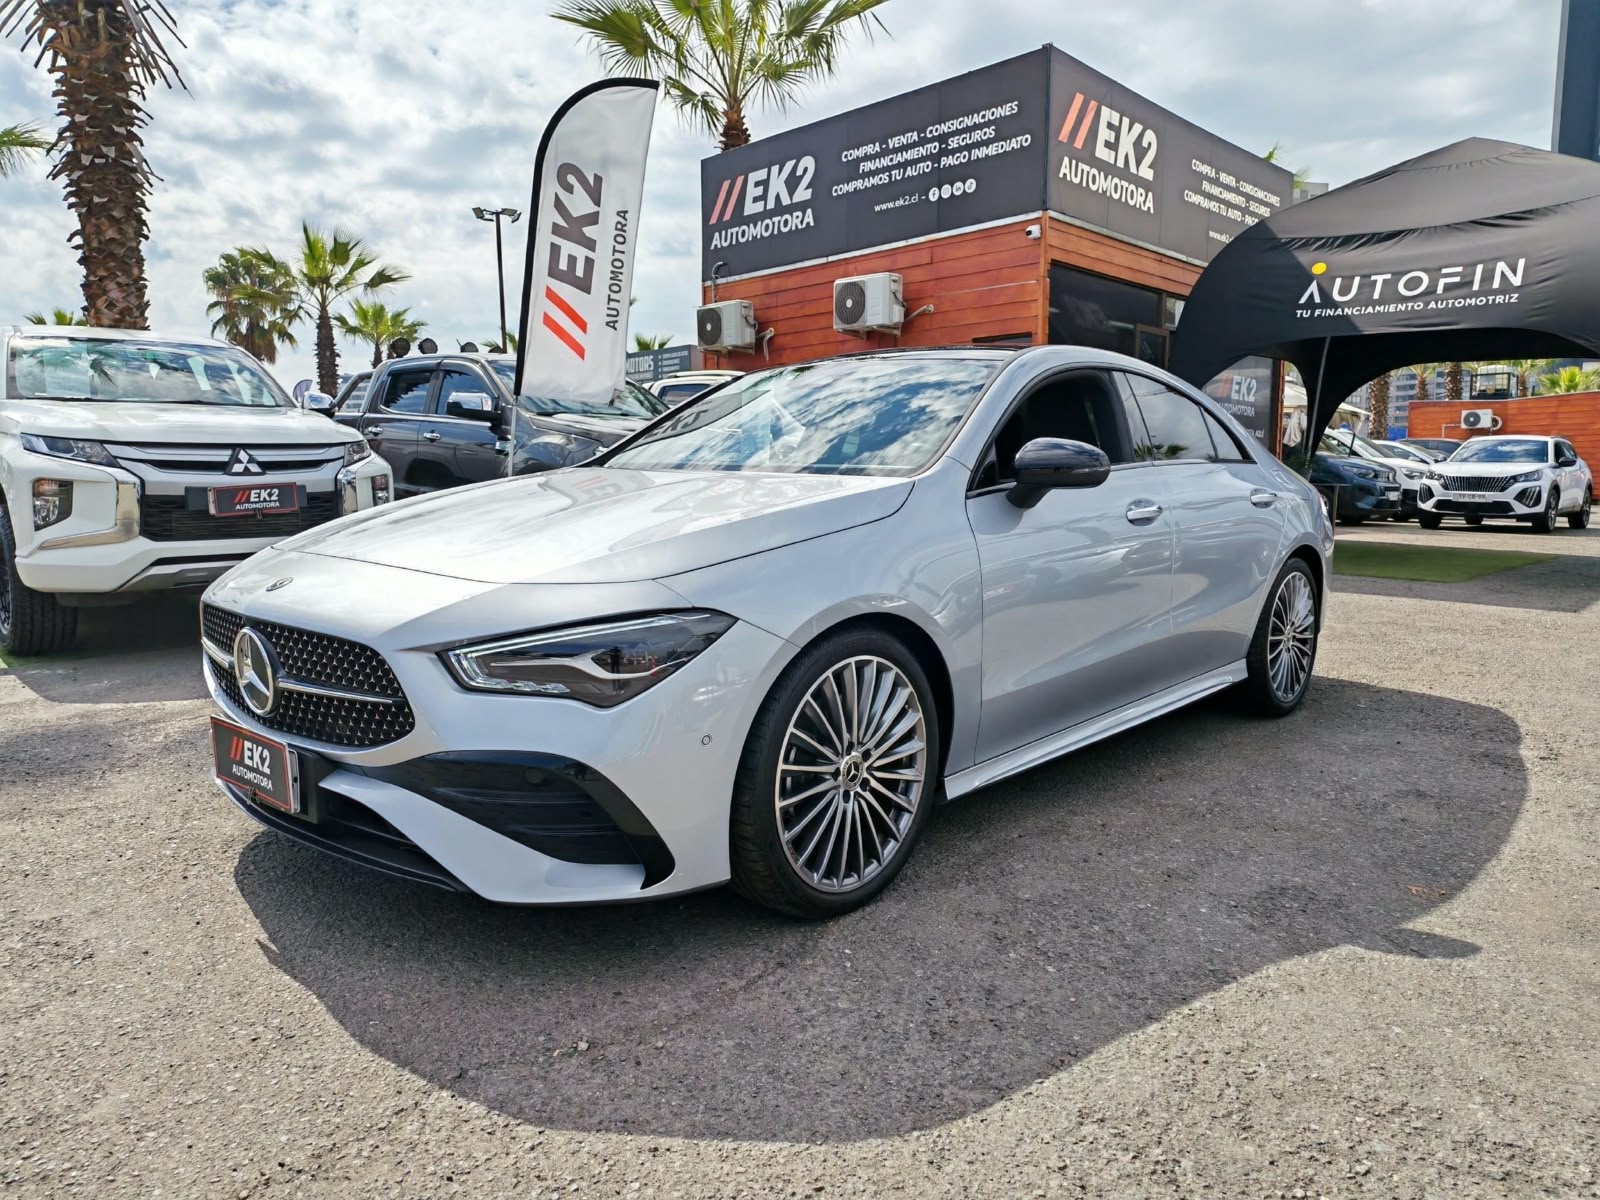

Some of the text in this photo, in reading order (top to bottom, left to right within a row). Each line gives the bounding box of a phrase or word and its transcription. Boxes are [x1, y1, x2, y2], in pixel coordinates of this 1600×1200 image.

[841, 142, 880, 162] COMPRA
[888, 131, 918, 150] VENTA
[926, 101, 1019, 138] CONSIGNACIONES
[859, 142, 939, 174] FINANCIAMIENTO
[947, 125, 996, 150] SEGUROS
[831, 172, 889, 196] COMPRAMOS
[891, 168, 903, 181] TU
[905, 160, 932, 179] AUTO
[940, 151, 969, 169] PAGO
[970, 134, 1031, 161] INMEDIATO
[1058, 156, 1154, 214] AUTOMOTORA
[1191, 159, 1216, 180] COMPRA
[1219, 171, 1236, 189] VENTA
[1239, 181, 1281, 207] CONSIGNACIONES
[873, 193, 919, 213] www.ek2.cl
[1201, 180, 1246, 208] FINANCIAMIENTO
[1249, 200, 1271, 217] SEGUROS
[1227, 206, 1242, 222] AUTO
[710, 208, 815, 250] AUTOMOTORA
[605, 209, 629, 331] AUTOMOTORA
[1298, 258, 1526, 304] AUTOFIN
[1295, 293, 1520, 318] TU FINANCIAMIENTO AUTOMOTRIZ
[235, 501, 280, 510] AUTOMOTORA
[232, 764, 273, 791] AUTOMOTORA
